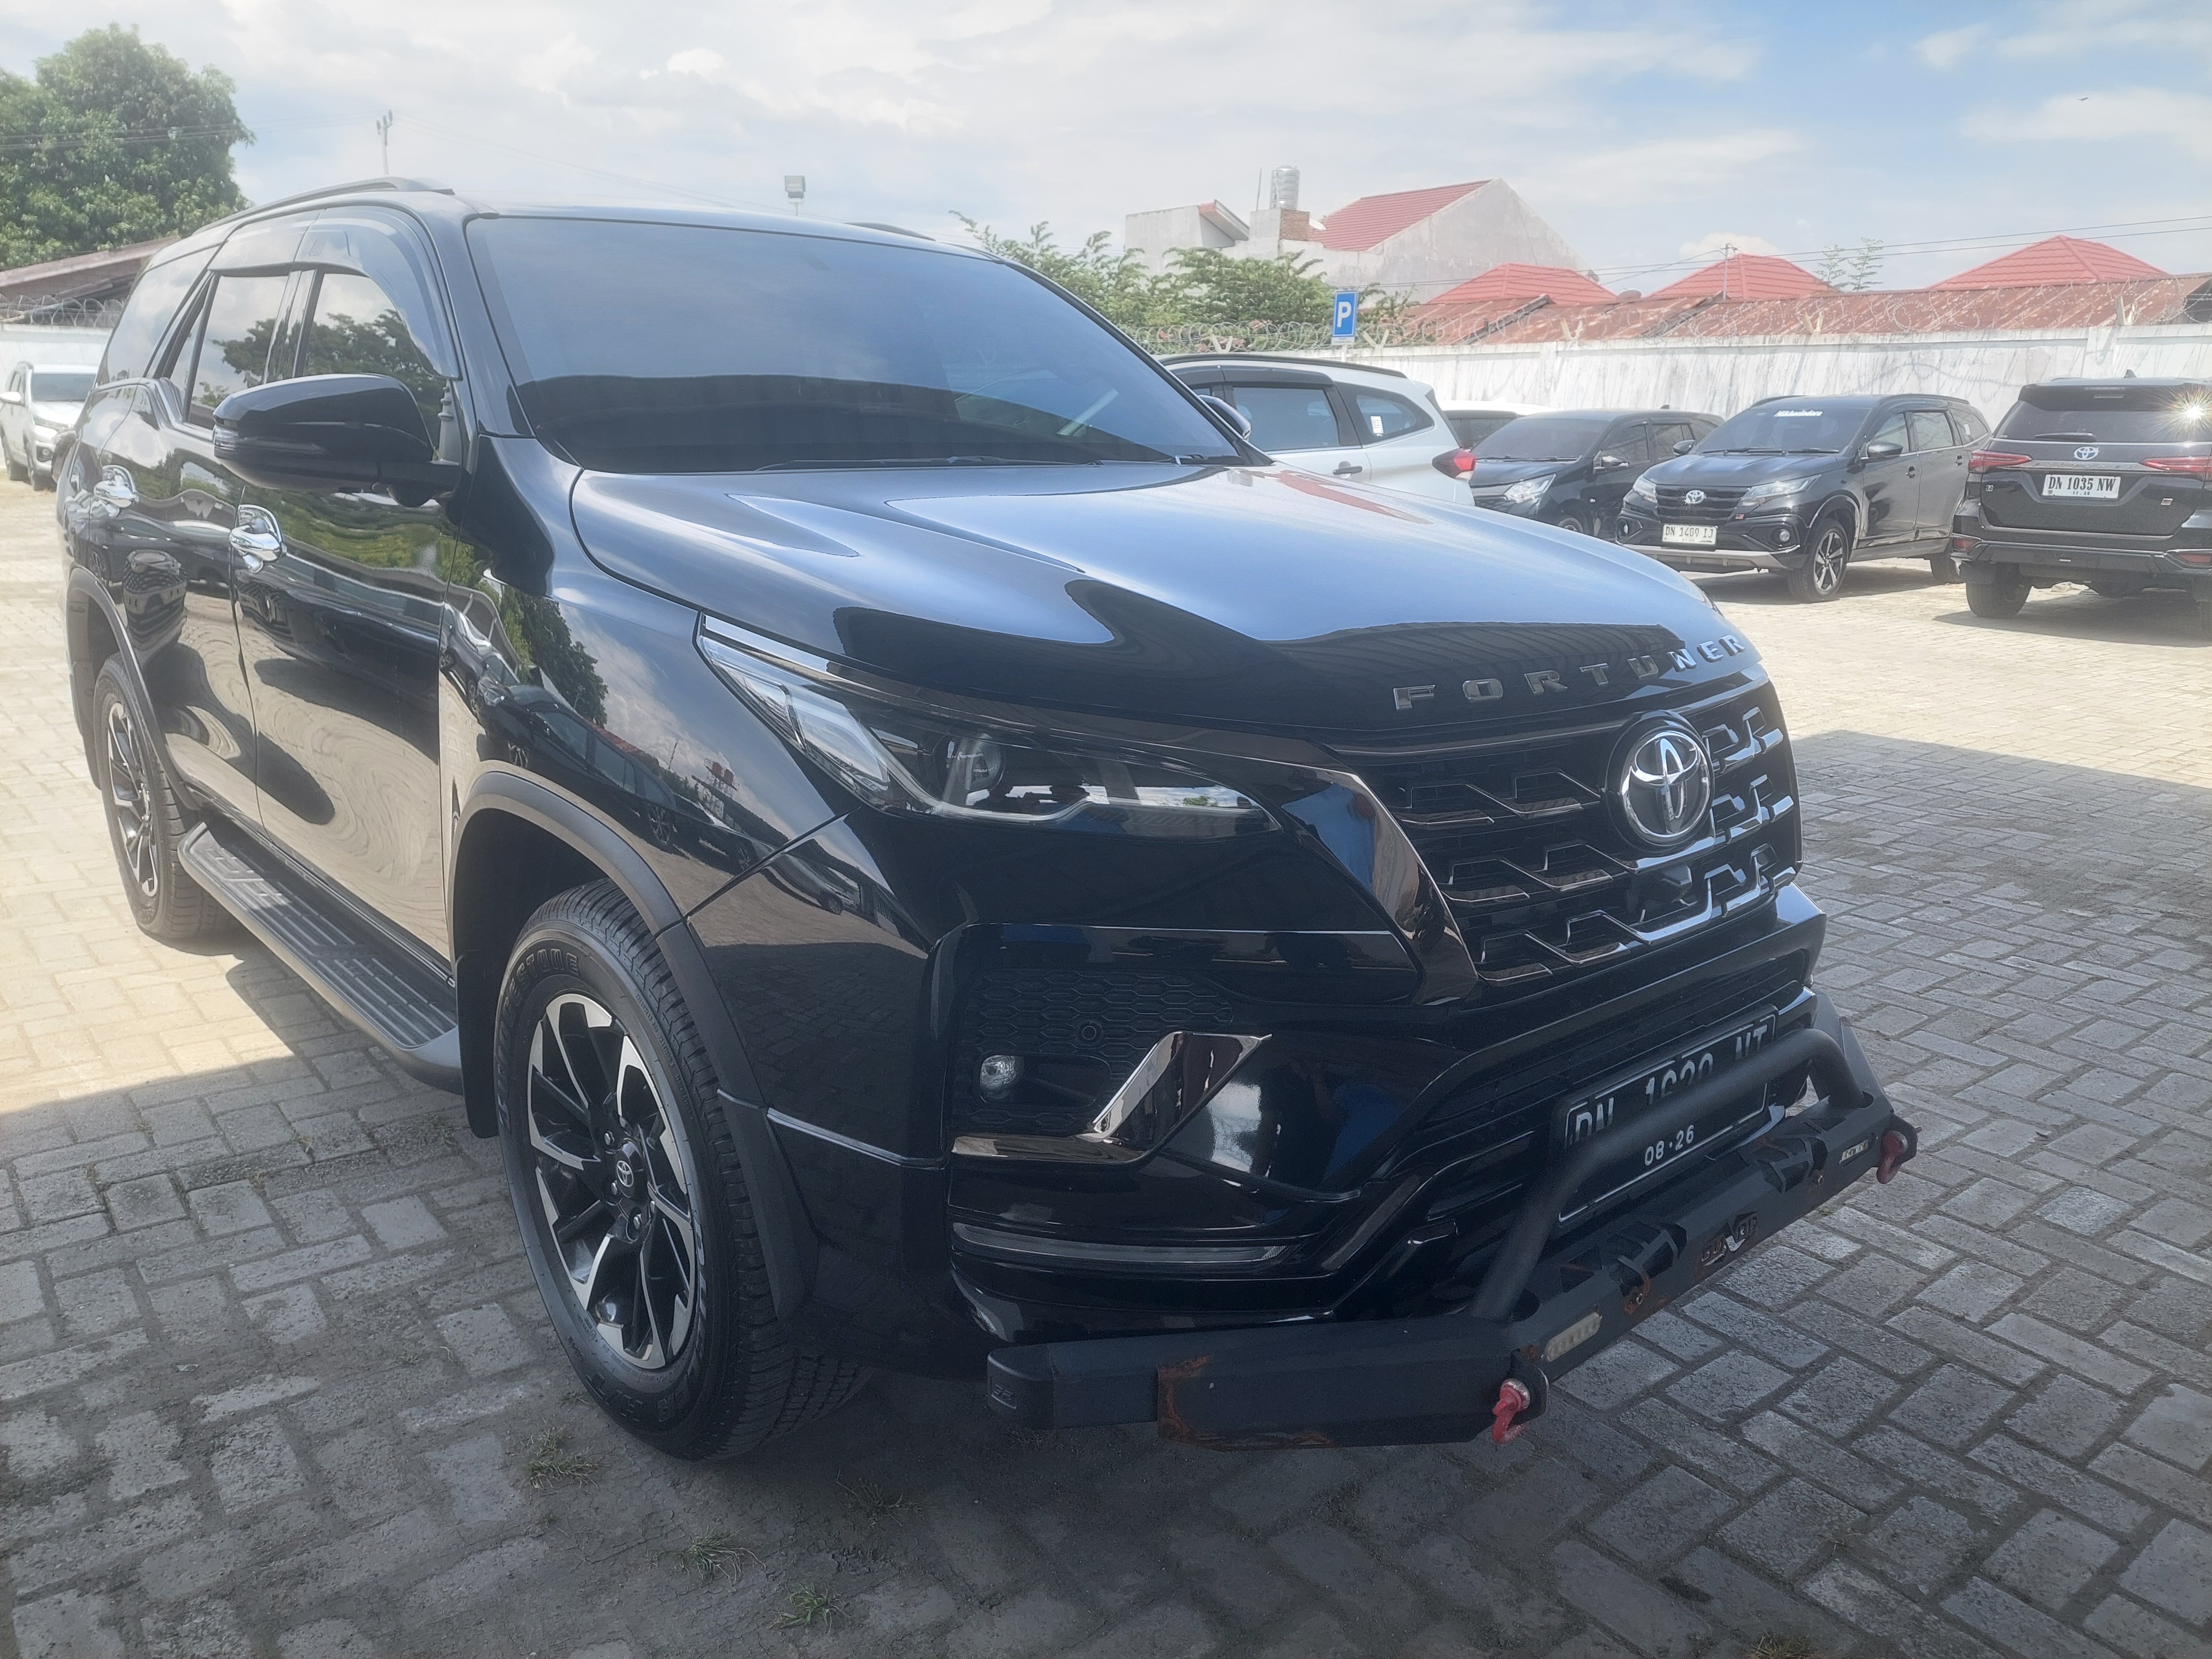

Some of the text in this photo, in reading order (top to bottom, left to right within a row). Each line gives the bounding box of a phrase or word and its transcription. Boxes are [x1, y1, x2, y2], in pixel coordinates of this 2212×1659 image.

[1337, 301, 1352, 328] P
[2048, 476, 2116, 491] DN 1035 NW
[1665, 526, 1676, 537] DN
[1393, 633, 1747, 710] FORTUNER
